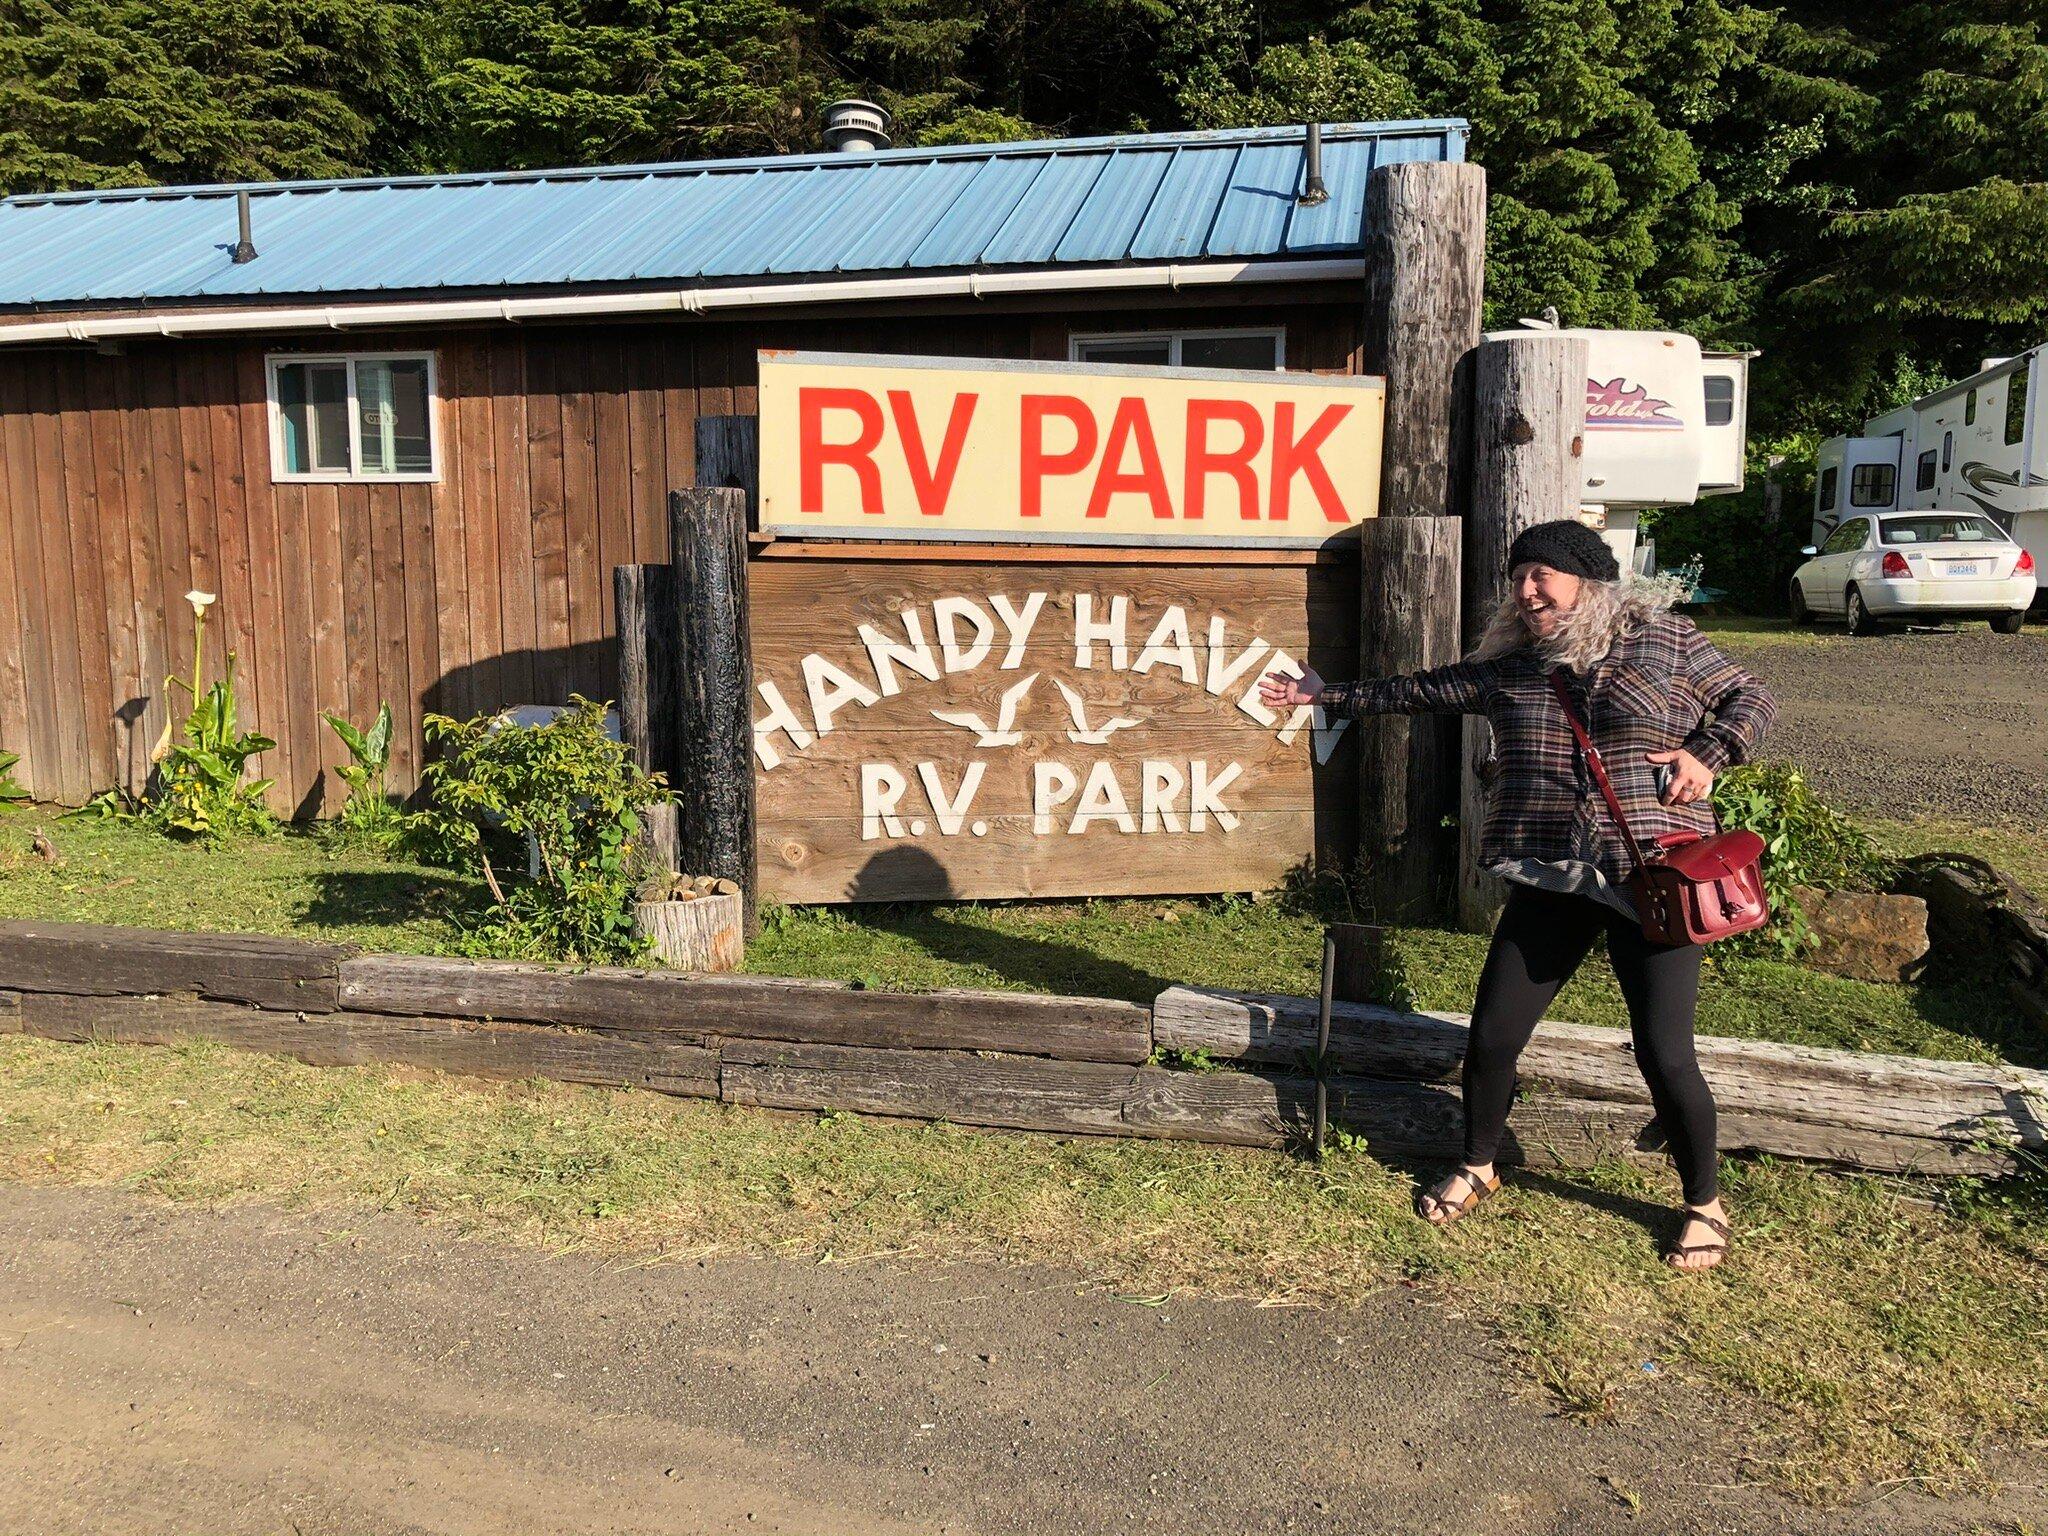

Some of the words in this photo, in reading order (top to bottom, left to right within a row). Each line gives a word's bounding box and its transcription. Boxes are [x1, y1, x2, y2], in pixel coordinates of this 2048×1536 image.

[799, 387, 979, 516] RV
[1020, 394, 1355, 523] PARK
[754, 592, 1047, 771] HANDY
[1074, 594, 1353, 767] HAVEN
[861, 761, 987, 840] R.V.
[1033, 761, 1243, 836] PARK
